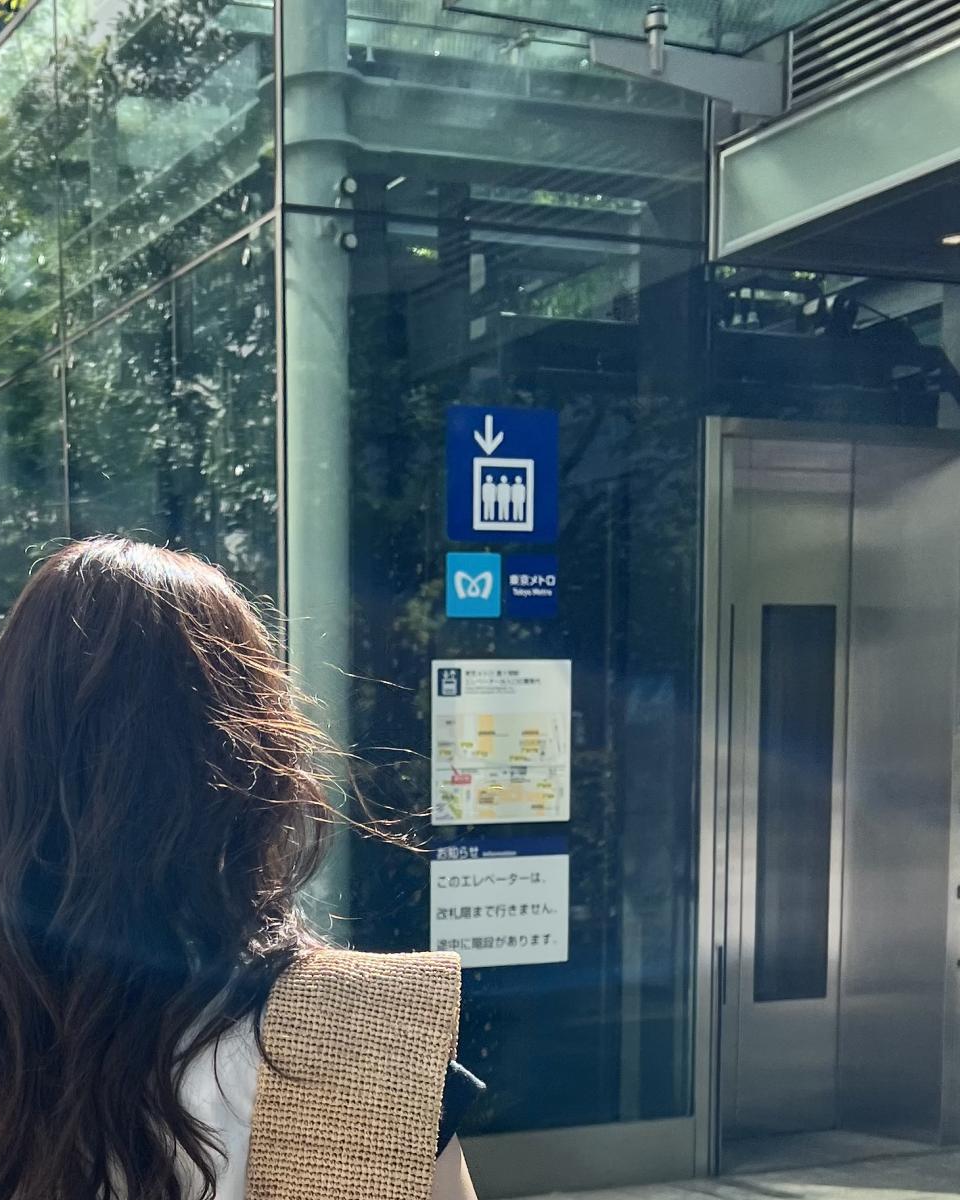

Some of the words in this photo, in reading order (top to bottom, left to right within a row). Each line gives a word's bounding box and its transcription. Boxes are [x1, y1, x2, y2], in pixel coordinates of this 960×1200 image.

[509, 574, 556, 587] 東京メトロ
[437, 872, 546, 889] このエレベーターは、
